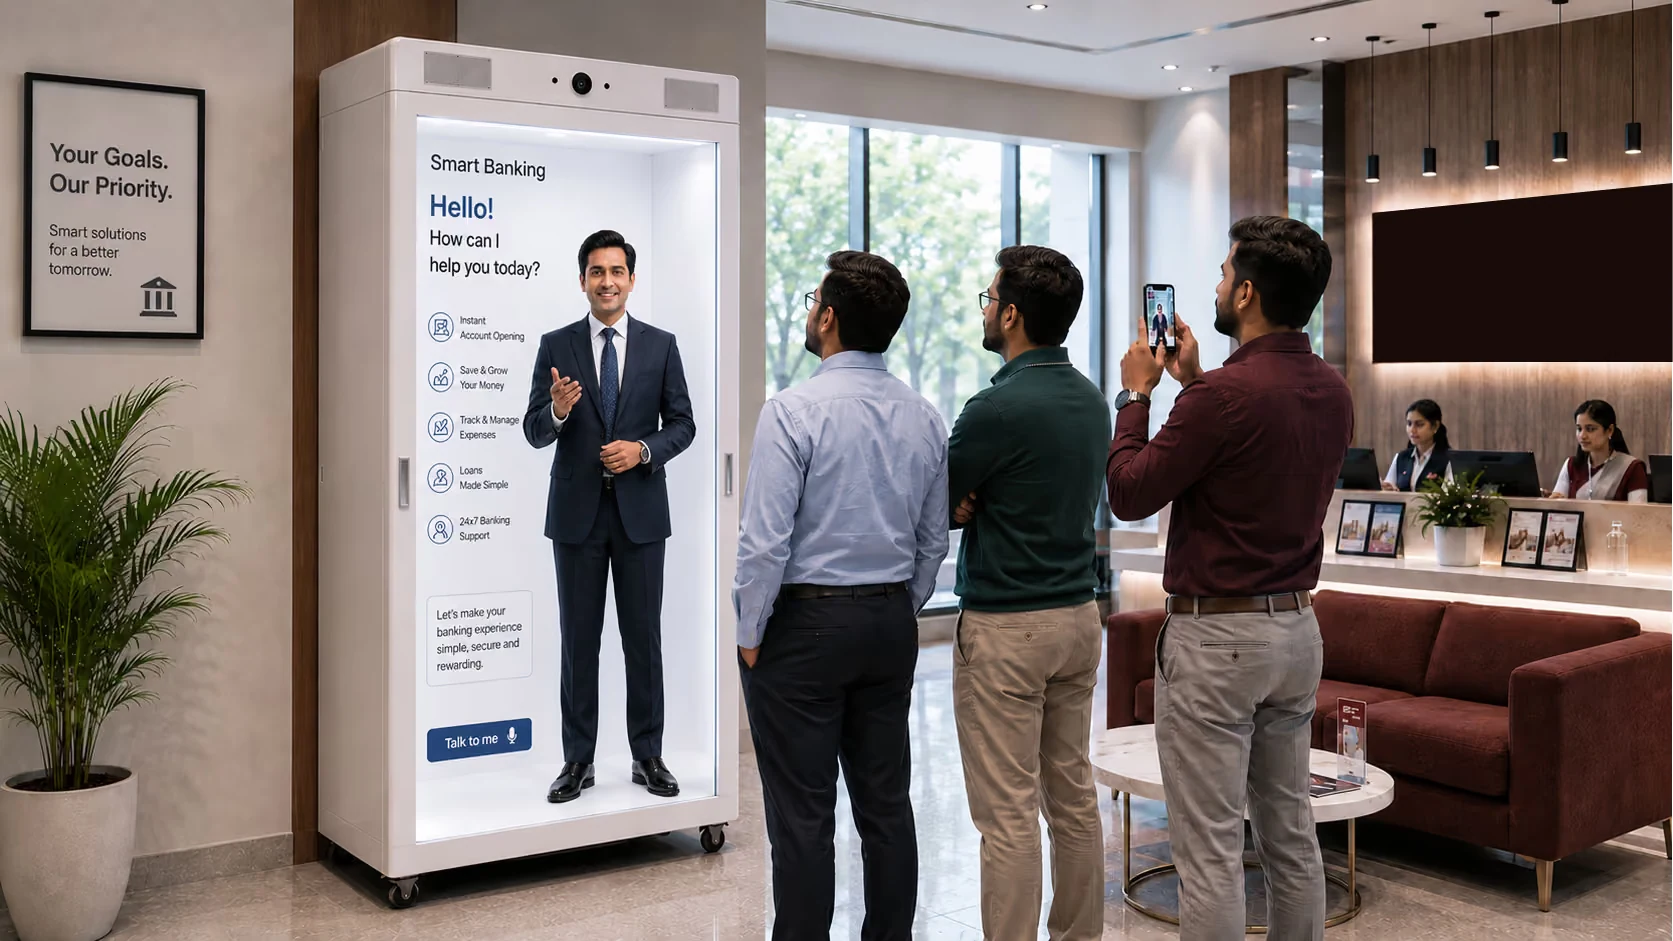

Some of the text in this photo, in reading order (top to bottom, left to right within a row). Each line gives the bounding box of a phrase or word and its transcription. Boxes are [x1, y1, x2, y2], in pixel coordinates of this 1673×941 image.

[50, 143, 168, 169] Your Goals.
[431, 154, 546, 182] Smart Banking
[50, 173, 173, 203] Our Priority.
[431, 194, 493, 220] Hello!
[49, 224, 147, 241] Smart solutions
[430, 230, 499, 248] How can I
[49, 243, 119, 259] for a better
[49, 263, 112, 277] tomorrow.
[430, 256, 541, 280] help you today?
[460, 316, 486, 325] Instant
[460, 331, 525, 343] Account Opening
[460, 366, 508, 375] Save & Grow
[460, 381, 505, 392] Your Money
[460, 416, 520, 426] Track & Manage
[460, 431, 496, 440] Expenses
[460, 466, 483, 475] Loans
[460, 480, 508, 490] Made Simple
[460, 516, 510, 526] 24x7 Banking
[460, 532, 490, 542] Support
[437, 607, 506, 621] Let's make your
[437, 622, 522, 637] banking experience
[437, 638, 520, 656] simple, secure and
[437, 658, 483, 671] rewarding.
[445, 734, 499, 749] Talk to me
